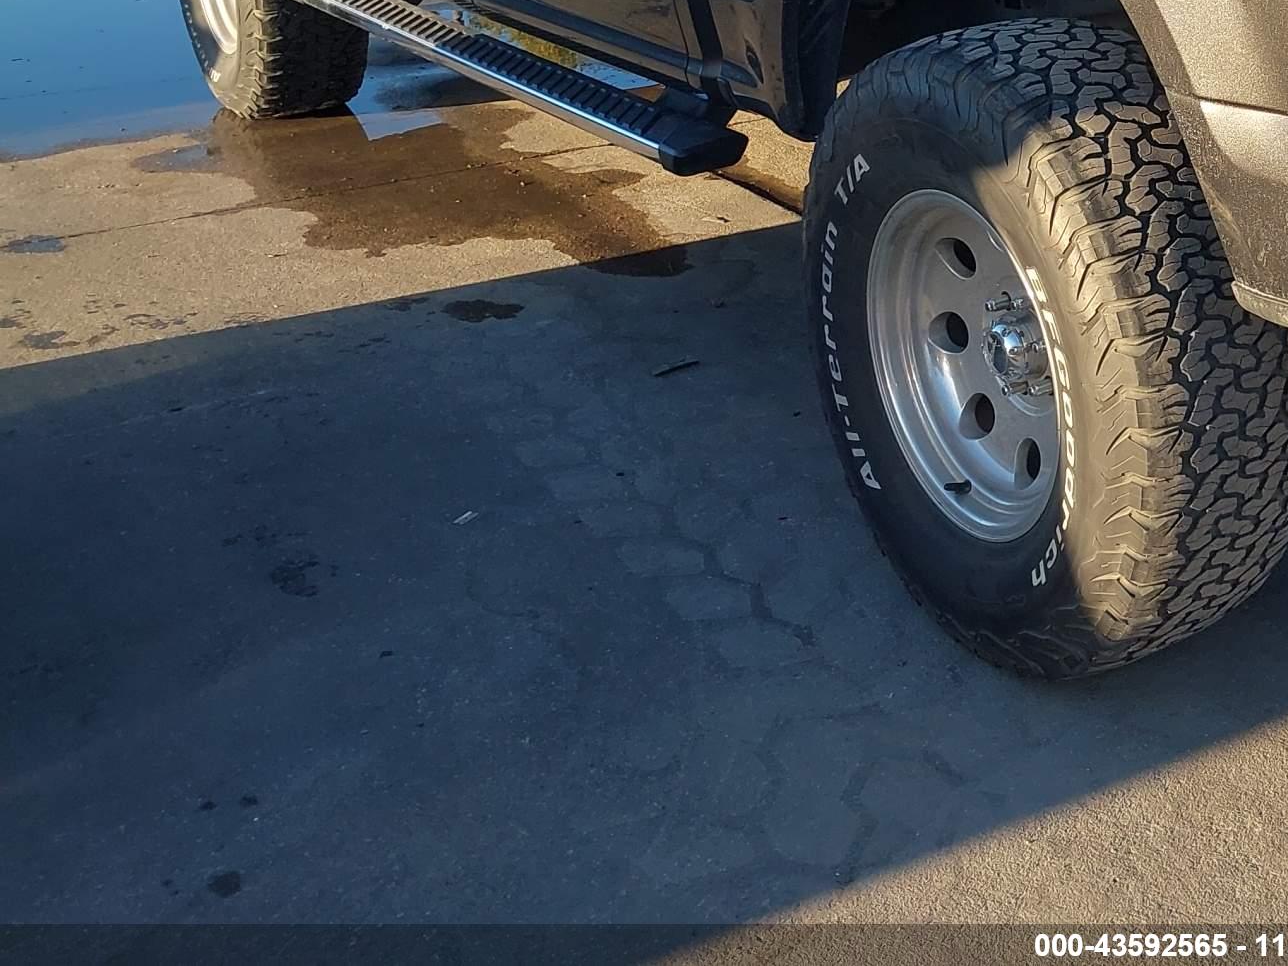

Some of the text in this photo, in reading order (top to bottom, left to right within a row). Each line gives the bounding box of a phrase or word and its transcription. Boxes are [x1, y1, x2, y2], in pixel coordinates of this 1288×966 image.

[822, 153, 882, 490] All-Terrain T/A
[1026, 266, 1076, 587] BFGoodrich
